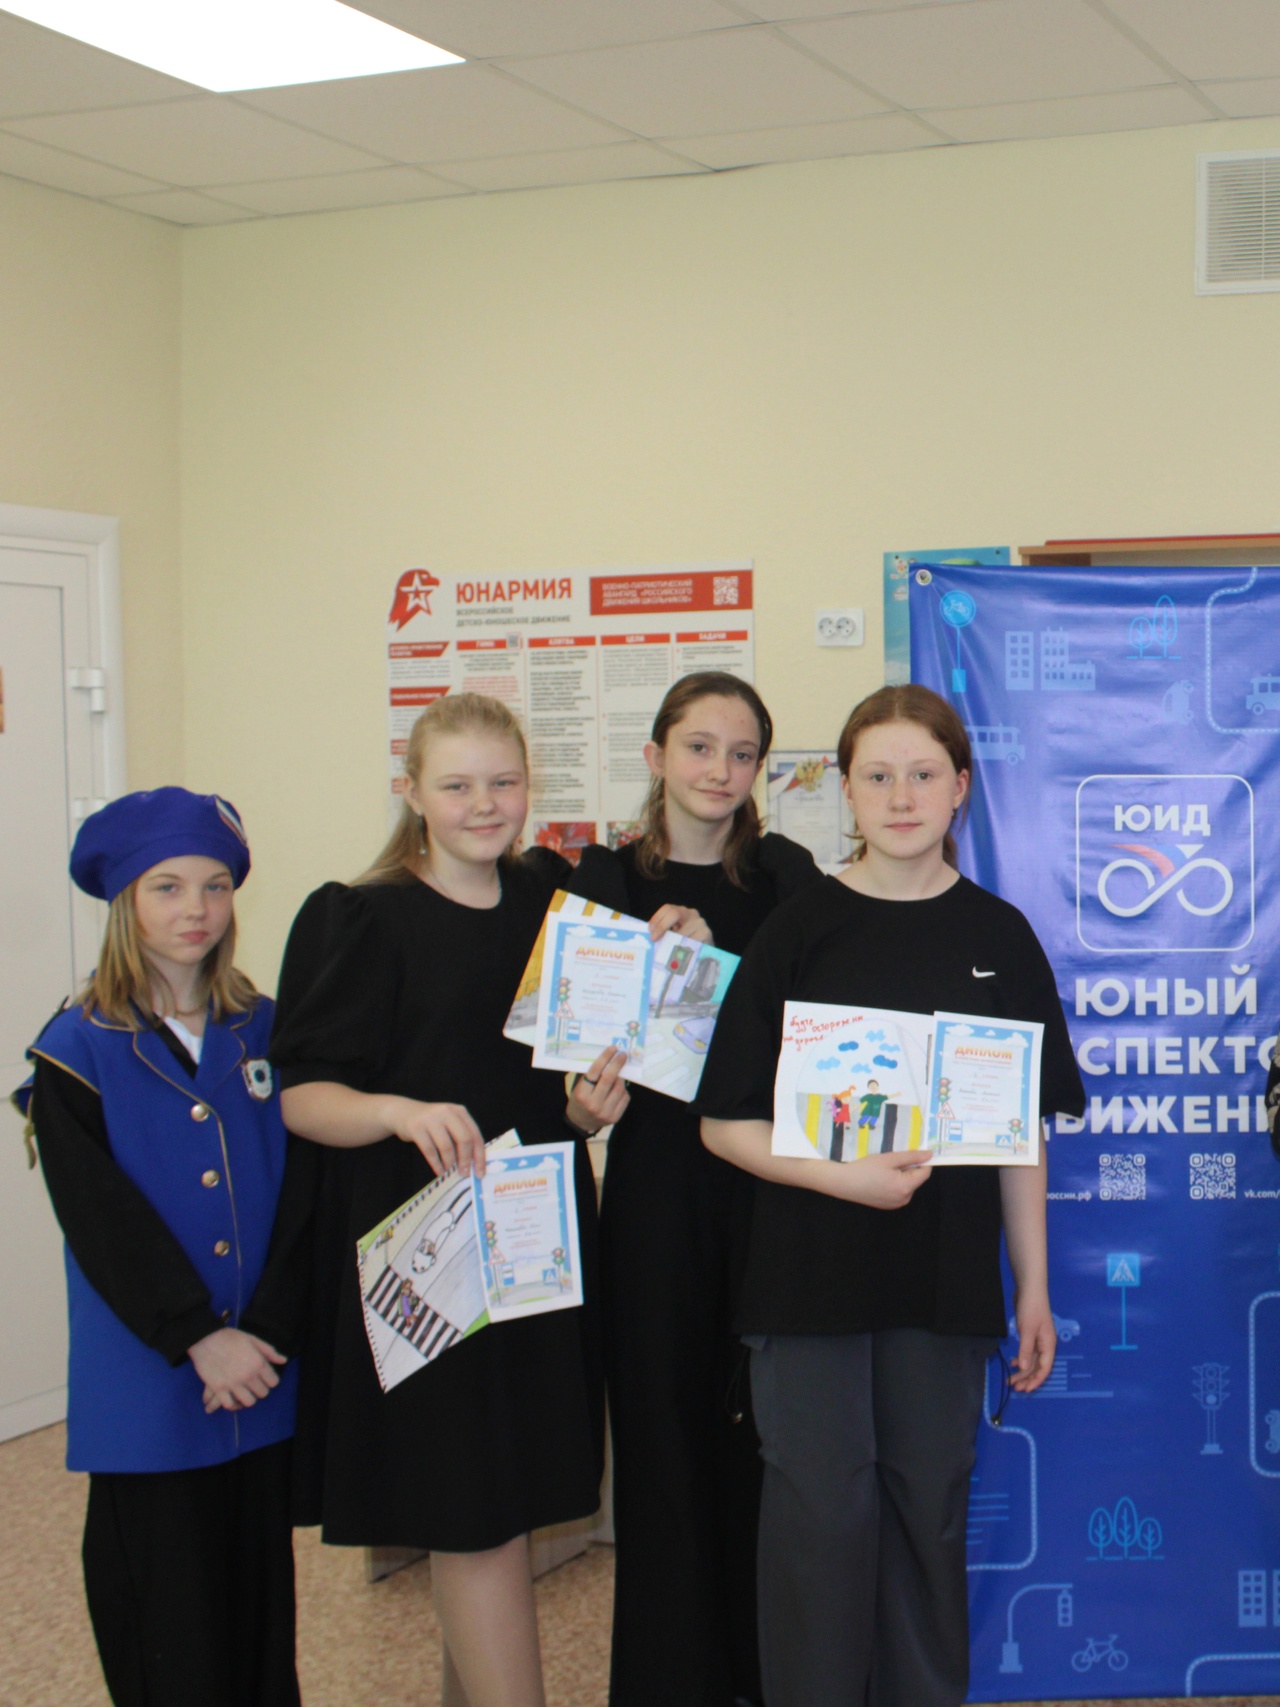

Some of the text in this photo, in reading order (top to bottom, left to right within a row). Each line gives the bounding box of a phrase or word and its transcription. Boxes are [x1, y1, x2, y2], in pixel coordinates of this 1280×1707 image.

[456, 577, 572, 604] ЮНАРМИЯ
[456, 606, 514, 616] ВСЕРОССИЙСКОЕ
[530, 615, 571, 625] ДВИЖЕНИЕ
[1114, 804, 1211, 836] ЮИД
[576, 946, 635, 960] ДИПЛОМ
[1075, 964, 1257, 1017] ЮНЫЙ
[954, 1045, 1013, 1060] ДИПЛОМ
[1070, 1035, 1279, 1076] СПЕКТ
[493, 1177, 547, 1195] ДИПЛОМ
